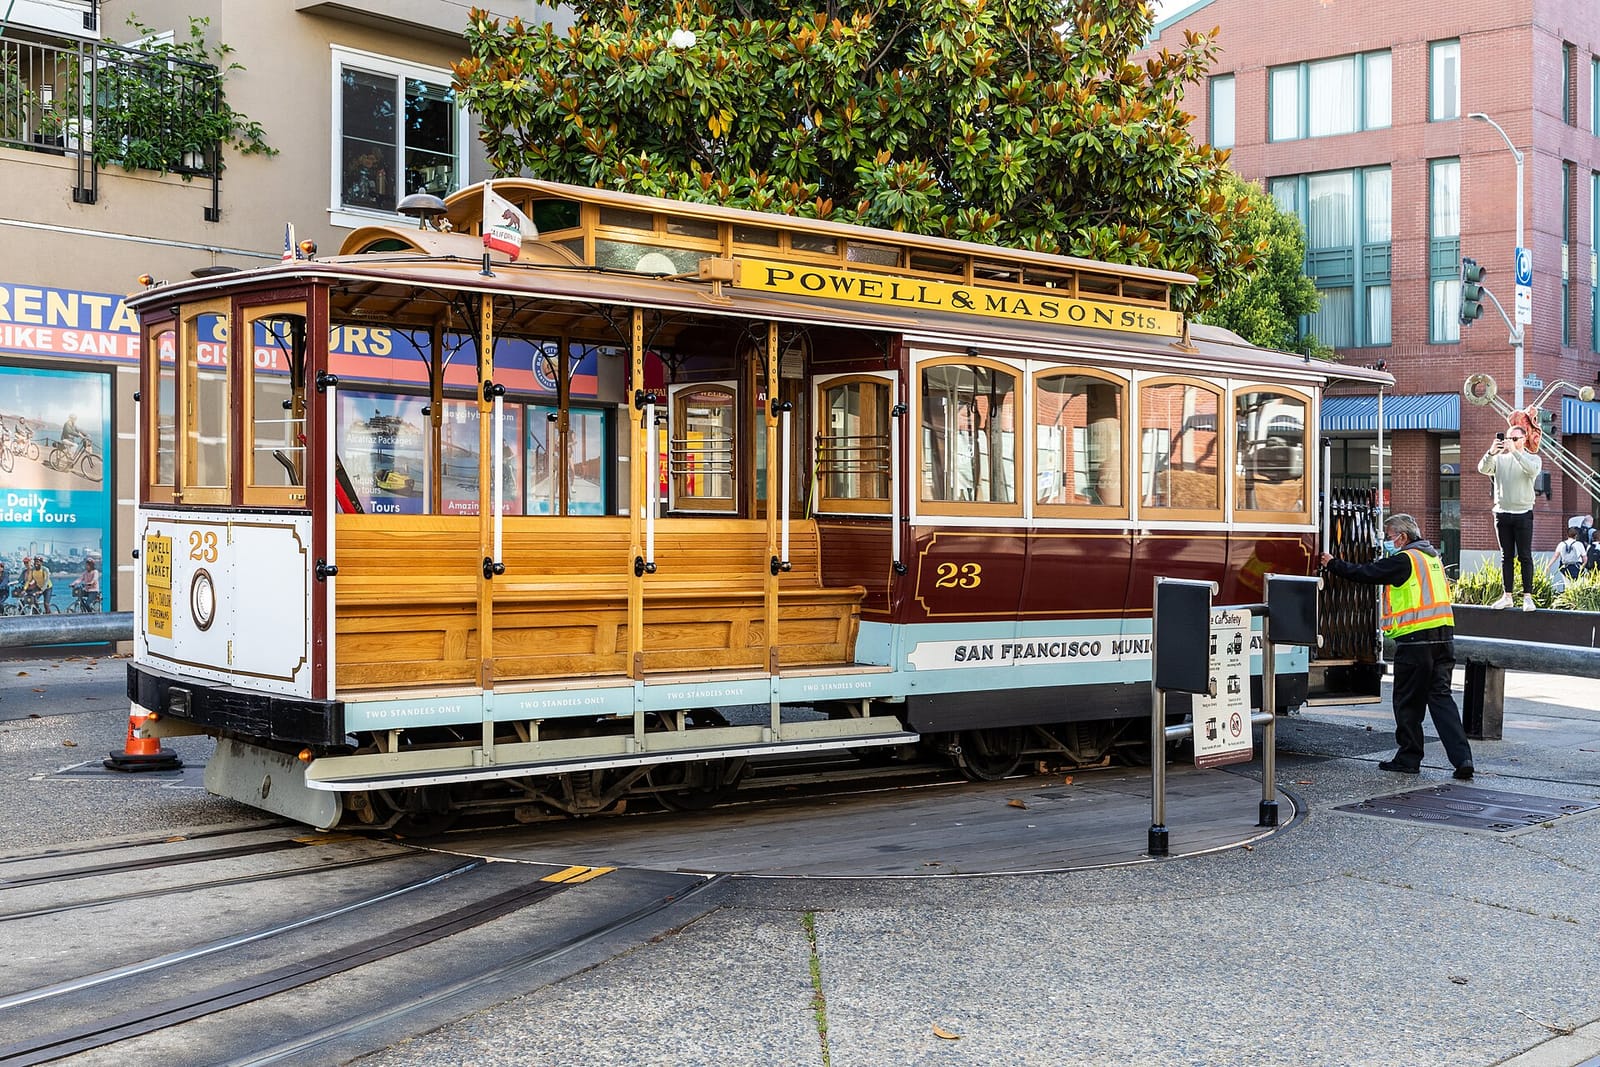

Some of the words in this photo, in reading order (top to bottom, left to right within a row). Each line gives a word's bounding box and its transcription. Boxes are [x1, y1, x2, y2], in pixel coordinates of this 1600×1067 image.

[765, 267, 942, 305] POWELL
[951, 290, 976, 310] &
[985, 294, 1114, 325] MASON
[0, 286, 141, 333] ENTA
[262, 319, 393, 356] TRS
[0, 326, 53, 349] IKE
[62, 331, 117, 355] SAN
[378, 436, 412, 447] Packages
[7, 493, 47, 511] Daily
[370, 501, 400, 513] Tours
[448, 501, 480, 510] Amazin
[0, 508, 32, 522] ided
[37, 509, 77, 523] Tours
[147, 541, 170, 554] POWELL
[189, 530, 218, 563] 23
[152, 554, 165, 564] AND
[146, 564, 169, 578] MARKET
[935, 562, 982, 589] 23
[954, 644, 994, 662] SAN
[1001, 640, 1102, 660] FRANCISCO
[1112, 639, 1153, 655] MUNI
[821, 682, 853, 690] STANDEES
[855, 681, 872, 689] ONLY
[667, 692, 684, 700] TWO
[687, 690, 722, 698] STANDEES
[725, 688, 744, 696] ONLY
[520, 701, 539, 709] TWO
[542, 698, 582, 708] STANDEES
[584, 696, 605, 705] ONLY
[366, 711, 387, 719] TWO
[390, 706, 436, 717] STANDEES
[438, 704, 461, 714] ONLY
